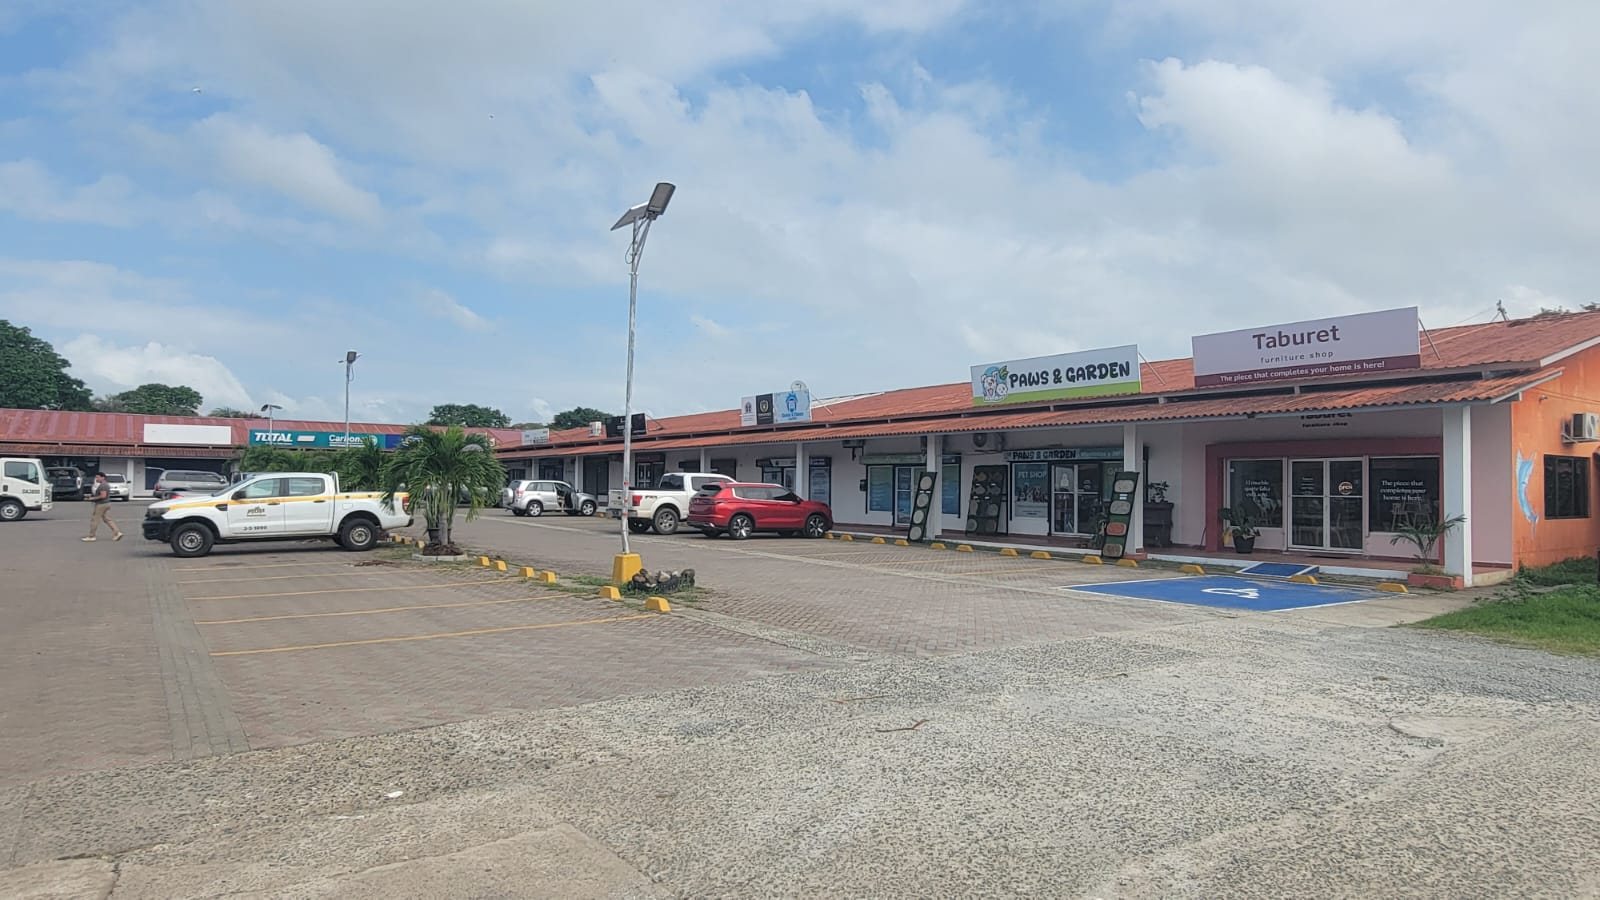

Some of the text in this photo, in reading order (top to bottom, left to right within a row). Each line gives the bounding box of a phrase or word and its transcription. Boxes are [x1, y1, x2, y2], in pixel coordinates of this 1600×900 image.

[1252, 325, 1341, 350] Taburet
[1260, 351, 1334, 364] furniture shop
[1009, 361, 1130, 388] PAWS & GARDEN
[1234, 373, 1253, 382] piece
[1254, 371, 1269, 379] that
[1270, 367, 1309, 377] completes
[1310, 366, 1328, 375] your
[1329, 364, 1351, 372] home
[1363, 360, 1385, 369] here!
[254, 432, 293, 442] TOTAL
[328, 434, 365, 443] Caron
[1042, 449, 1077, 459] GARDEN
